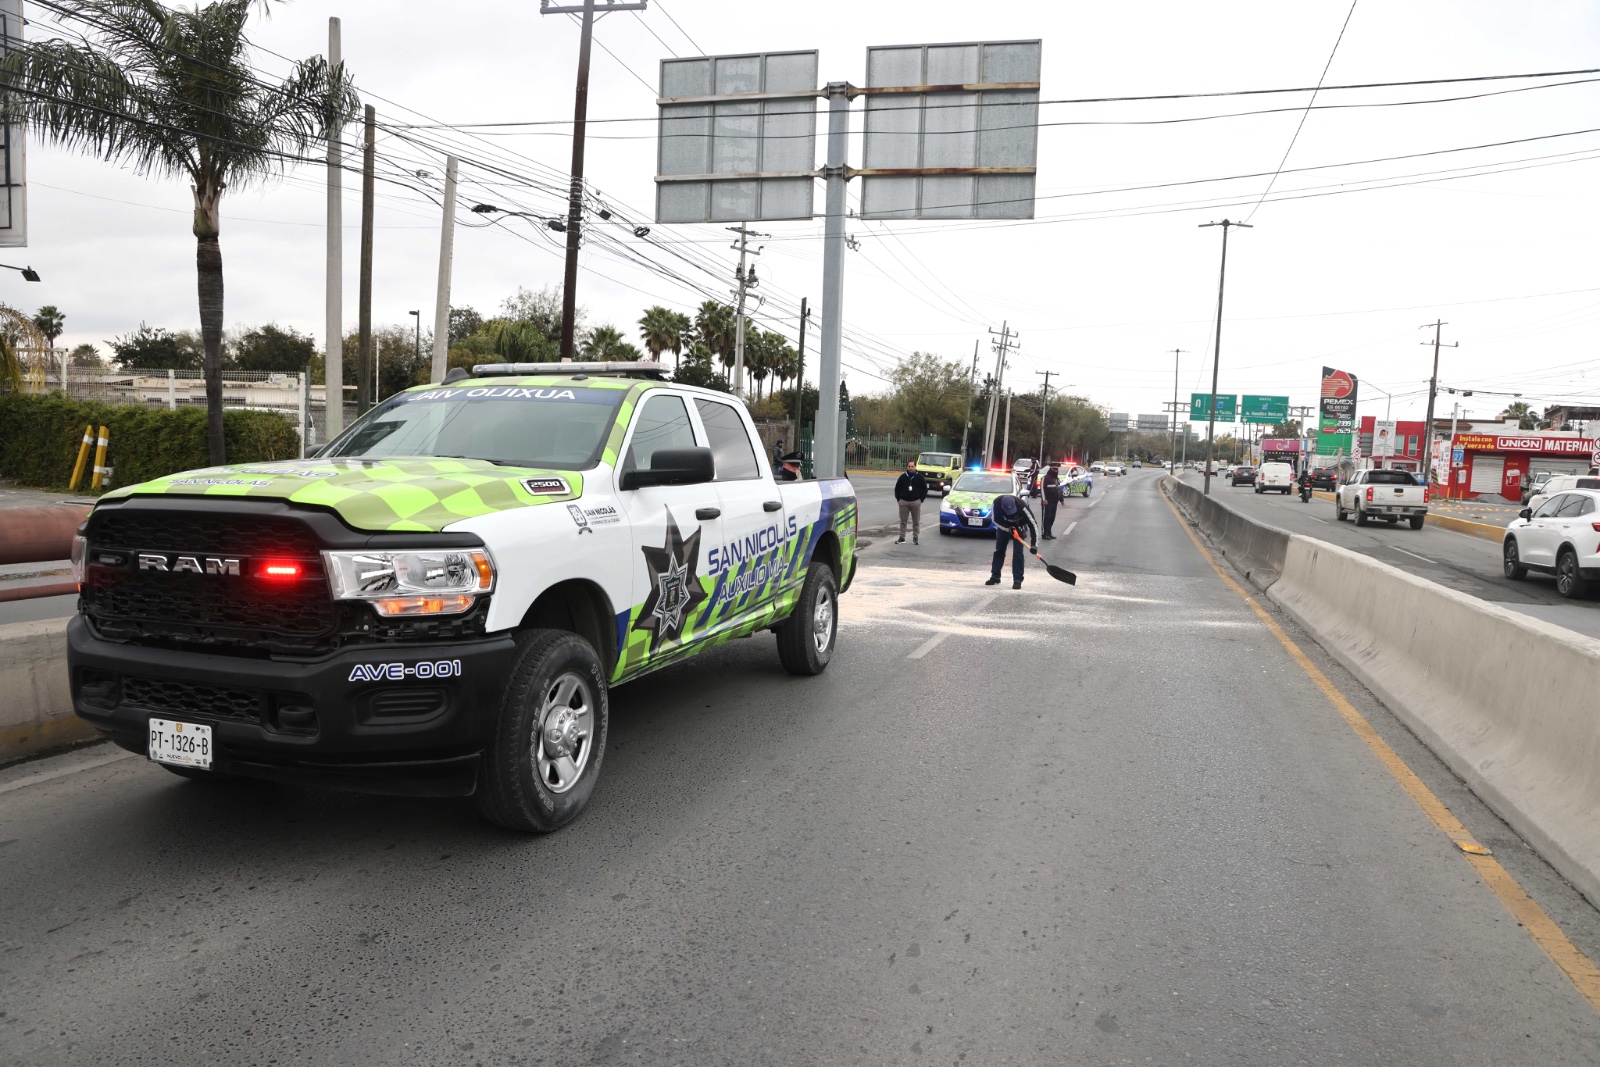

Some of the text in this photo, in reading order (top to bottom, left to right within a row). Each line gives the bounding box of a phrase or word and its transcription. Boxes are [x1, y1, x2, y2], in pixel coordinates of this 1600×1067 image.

[1453, 453, 1463, 461] 27
[531, 480, 560, 488] 2500
[708, 515, 798, 577] SAN NICOLAS
[138, 553, 241, 576] RAM
[718, 556, 789, 606] AUXILIO VIAL
[347, 659, 462, 682] AVE-001
[150, 730, 208, 755] PT-1326-B
